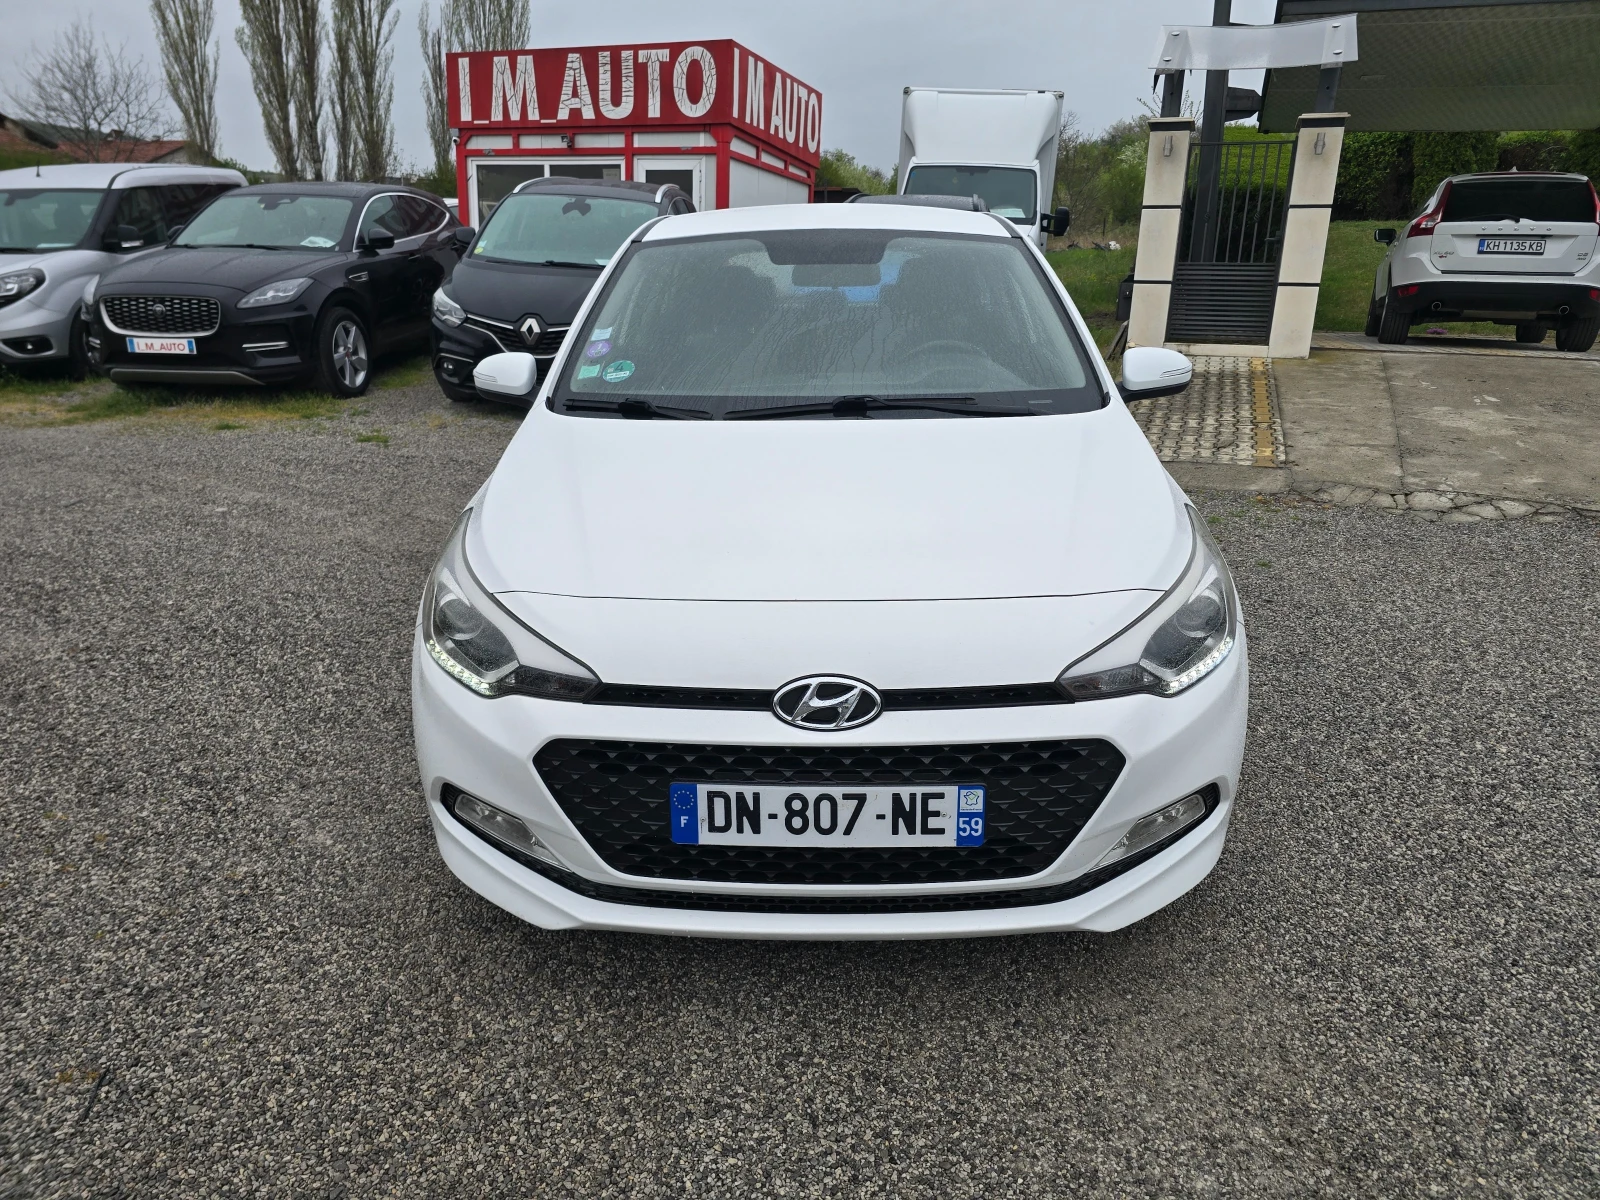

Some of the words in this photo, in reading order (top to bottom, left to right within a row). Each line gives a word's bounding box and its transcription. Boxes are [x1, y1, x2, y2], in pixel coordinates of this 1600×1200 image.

[745, 55, 765, 131] M
[769, 71, 820, 154] AUTO
[1485, 240, 1501, 251] KH
[1503, 241, 1528, 251] 1135
[1528, 241, 1543, 252] KB
[680, 815, 688, 827] F
[706, 790, 946, 836] DN-807-NE
[958, 817, 983, 837] 59
